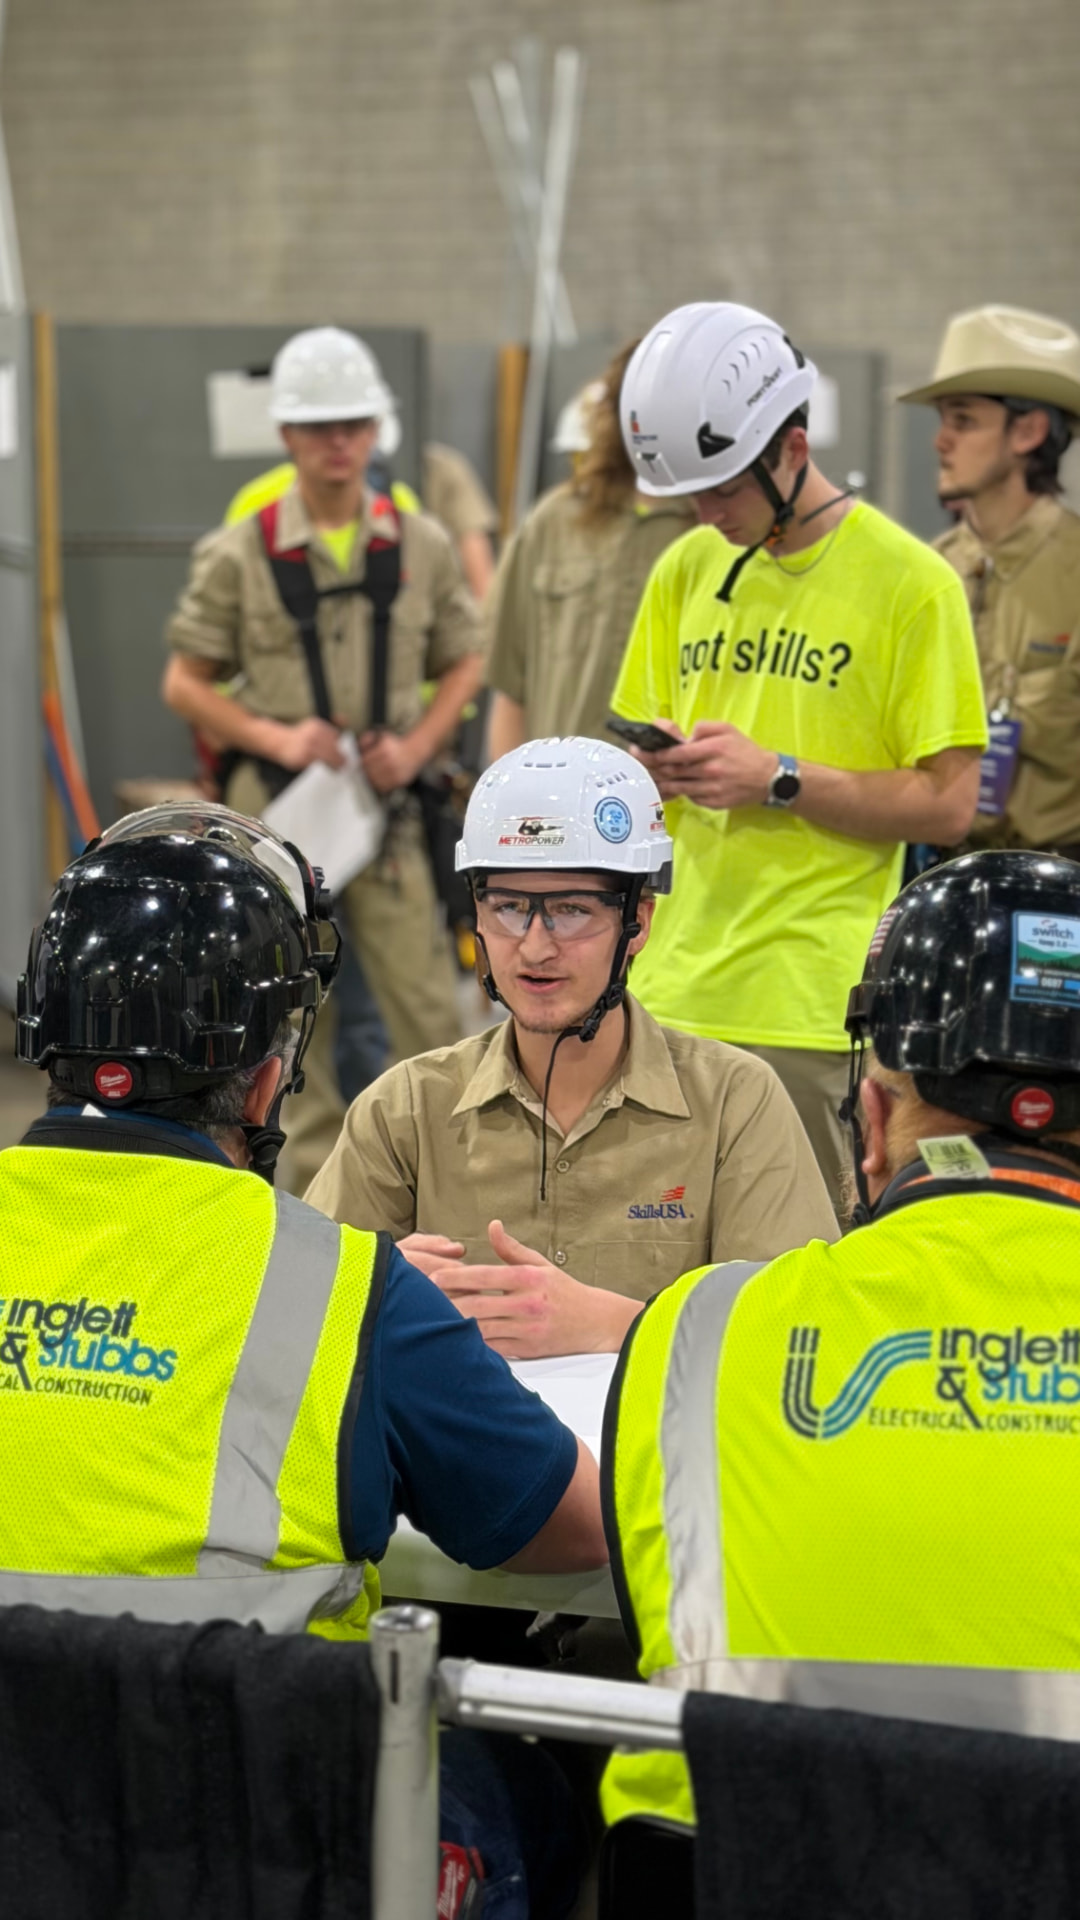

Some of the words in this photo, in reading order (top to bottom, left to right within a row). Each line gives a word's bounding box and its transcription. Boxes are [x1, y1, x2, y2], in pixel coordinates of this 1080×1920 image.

[680, 631, 725, 690] got
[733, 628, 852, 688] skills?
[498, 836, 565, 845] METROPOWER
[1032, 926, 1074, 940] switch
[627, 1203, 687, 1219] SkillsUSA
[0, 1332, 32, 1391] &
[39, 1331, 178, 1381] stubbs
[35, 1376, 152, 1406] CONSTRUCTION
[936, 1367, 982, 1429] &
[869, 1407, 966, 1430] ELECTRICAL
